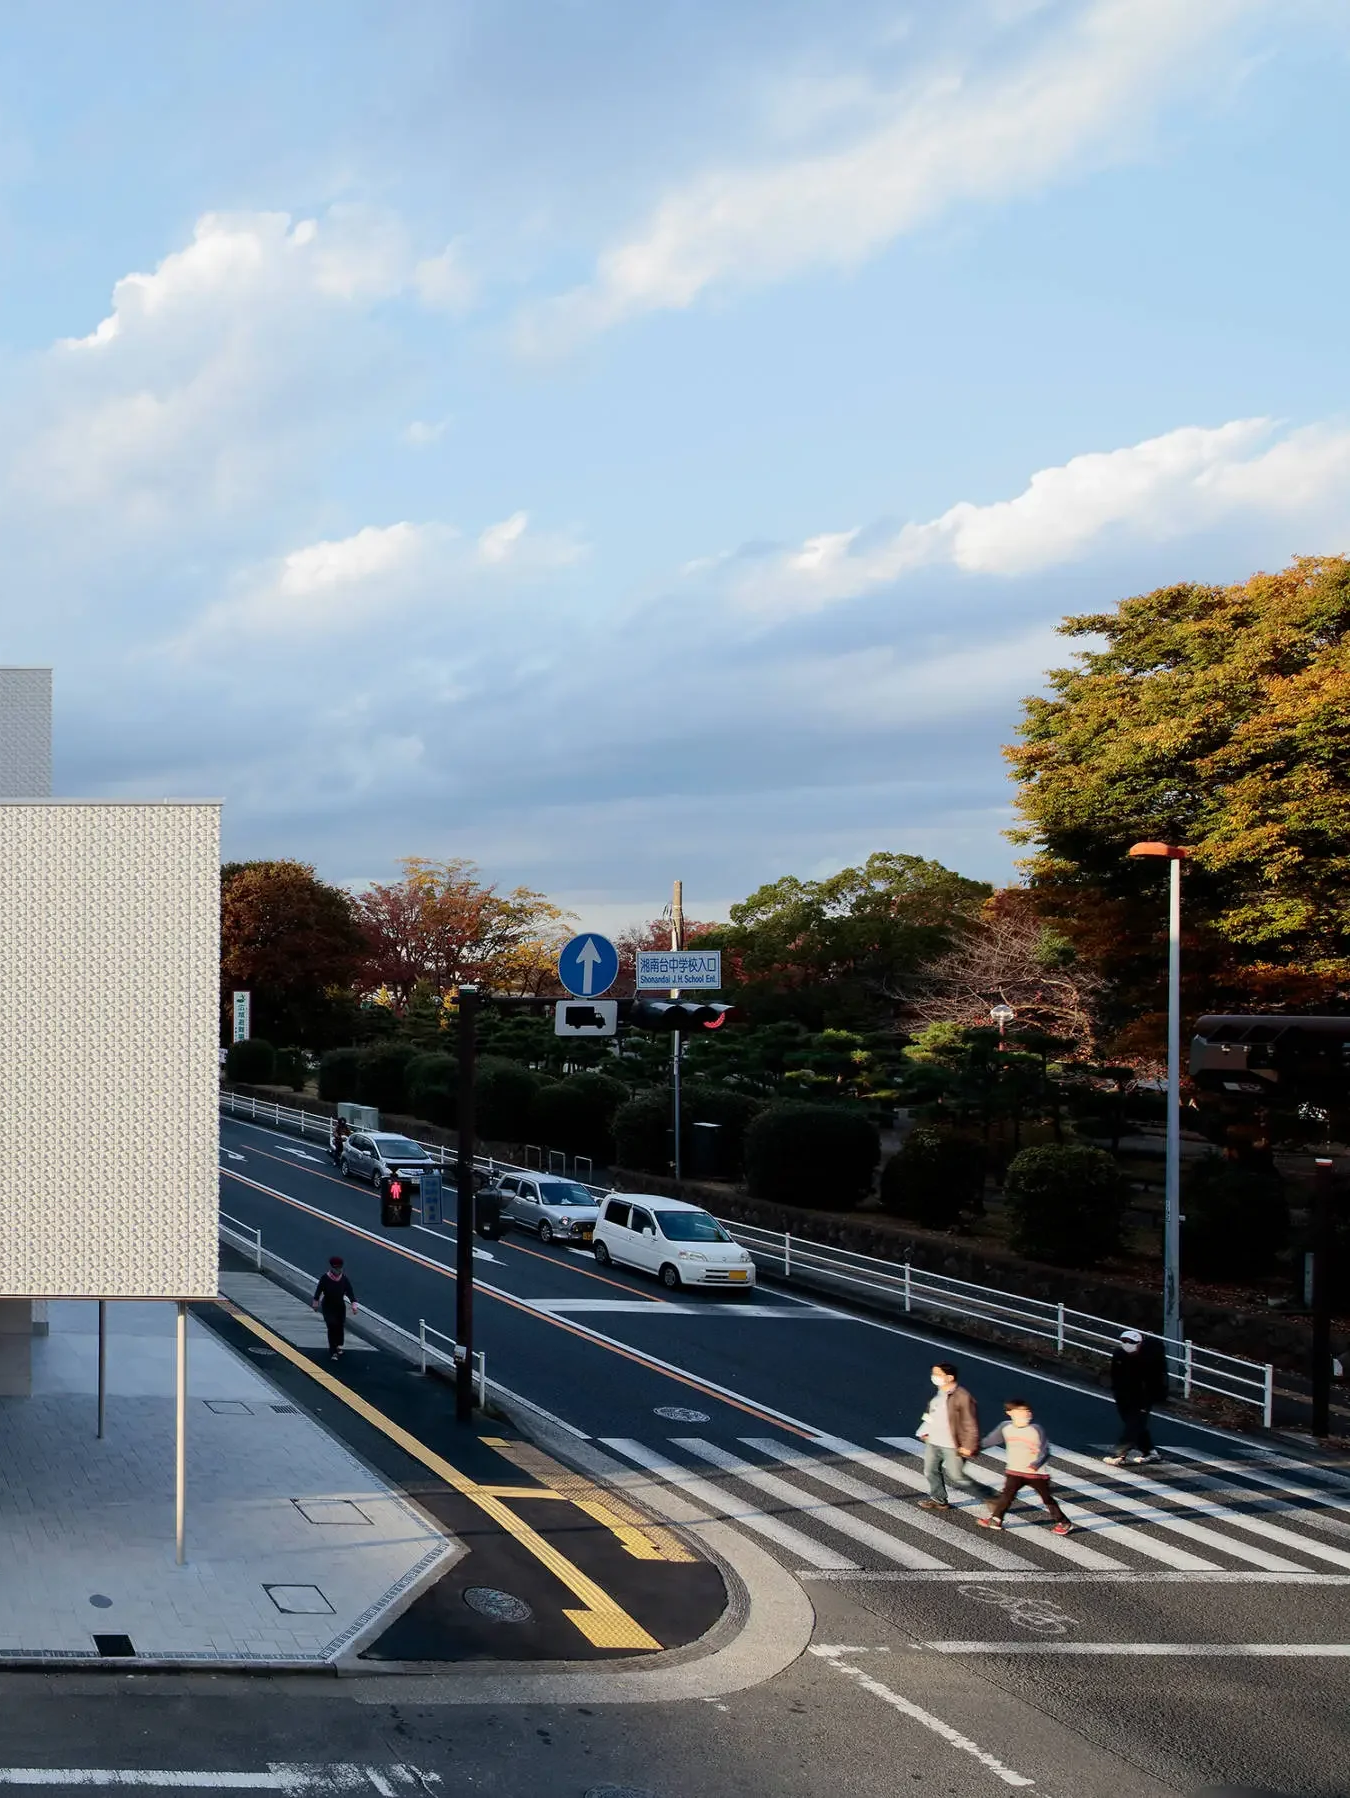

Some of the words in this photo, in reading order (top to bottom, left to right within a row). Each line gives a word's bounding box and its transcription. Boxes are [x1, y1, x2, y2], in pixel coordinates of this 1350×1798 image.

[641, 957, 716, 973] 湘南台中学校入口
[641, 975, 670, 984] Shonandai
[684, 975, 704, 984] School
